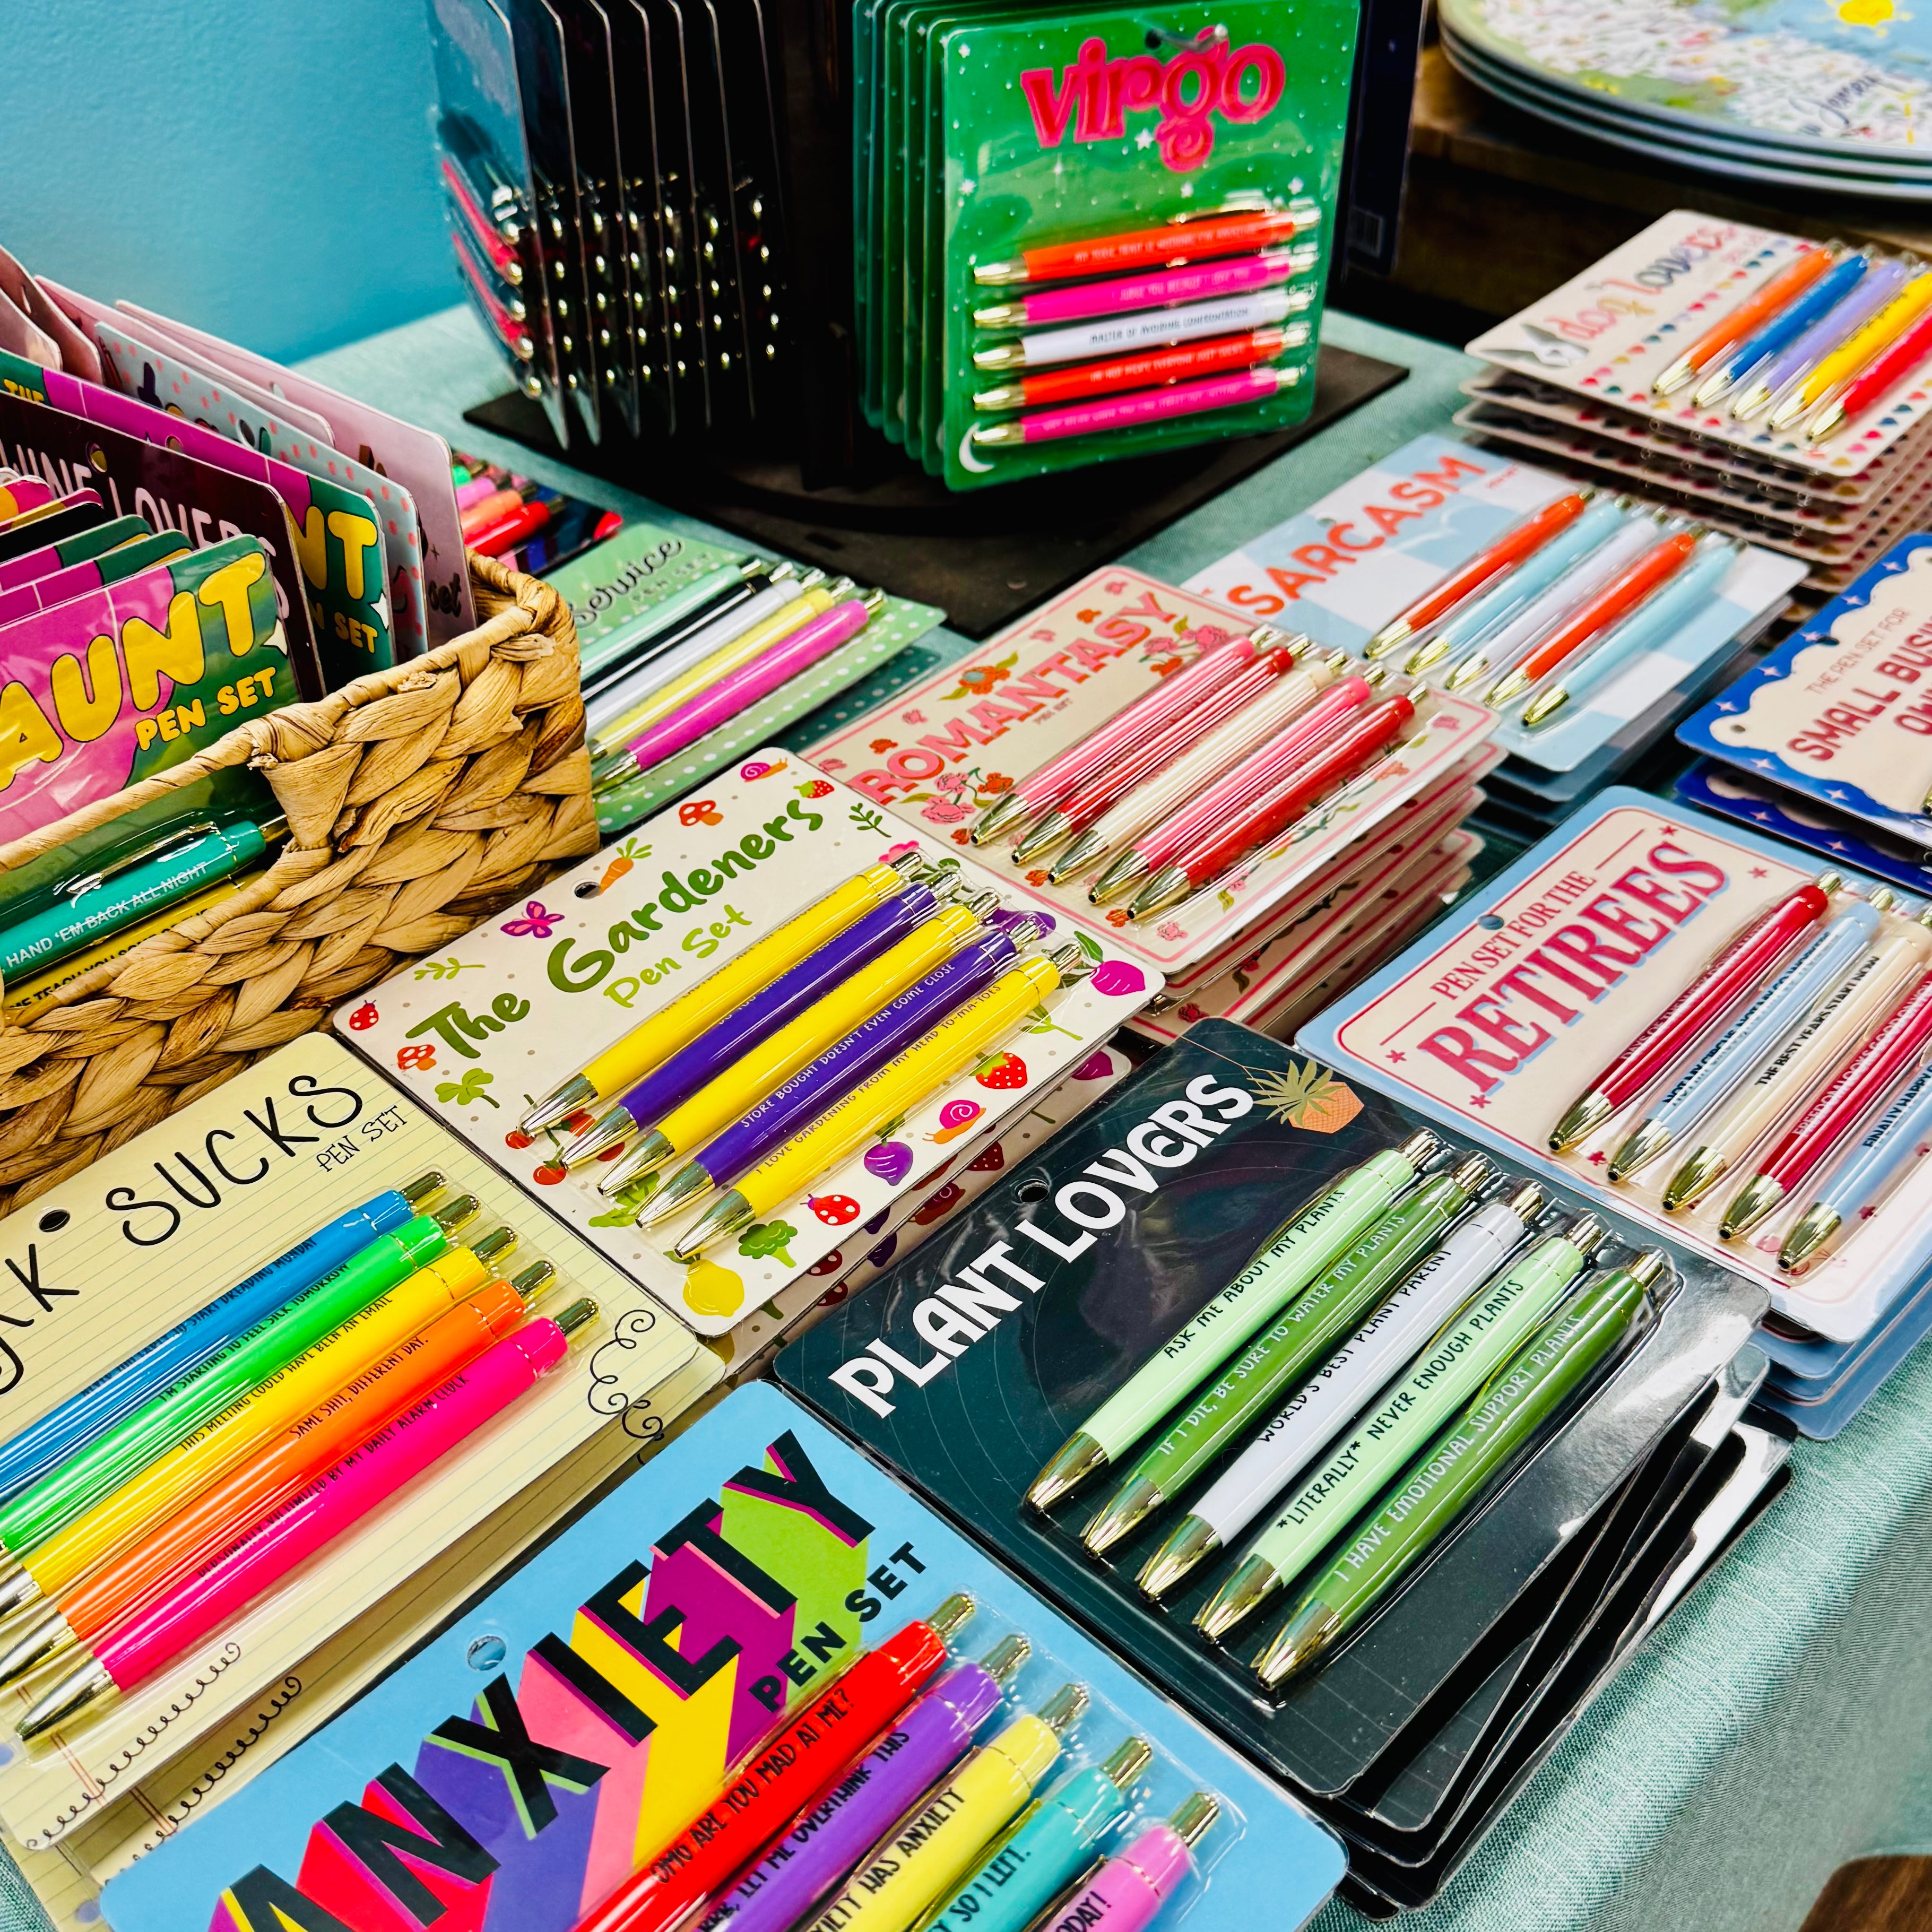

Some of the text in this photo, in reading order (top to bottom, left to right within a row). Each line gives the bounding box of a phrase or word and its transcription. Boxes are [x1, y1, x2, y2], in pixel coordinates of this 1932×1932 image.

[1021, 25, 1286, 173] virgo
[1227, 456, 1486, 616] SARCASM
[334, 612, 378, 654] SET
[847, 591, 1176, 805] ROMANTASY
[1804, 607, 1911, 694] THE PEN SET FOR
[134, 666, 276, 751] PEN SET
[1787, 688, 1901, 761] SMALL
[5, 935, 54, 969] HAND
[83, 898, 130, 931] BACK
[128, 883, 162, 908] ALL
[160, 860, 209, 894] NIGHT
[405, 1001, 530, 1059] The
[547, 799, 824, 993] Gardeners
[603, 956, 681, 1008] Pen
[681, 904, 753, 959] Set
[1416, 841, 1729, 1095] RETIREES
[1430, 870, 1598, 1000] PEN SET FOR THE
[741, 963, 955, 1128] STORE BOUGHT DOESN'T EVEN COME CLOSE
[764, 1145, 793, 1167] LOVE
[794, 1095, 856, 1143] GARDENING
[857, 1068, 891, 1093] FROM
[892, 1051, 910, 1067] MY
[911, 1031, 938, 1052] HEAD
[940, 981, 1001, 1029] TO-MA-TOES
[1754, 1064, 1780, 1091] THE
[1772, 1039, 1803, 1071] BEST
[1795, 1008, 1831, 1046] YEARS
[1823, 977, 1859, 1015] START
[1852, 953, 1881, 983] NOW
[1894, 1068, 1932, 1111] HAPPY
[106, 1075, 363, 1246] SUCKS
[316, 1105, 408, 1173] PEN SET
[1791, 1078, 1849, 1142] FREEDOM
[187, 1299, 221, 1327] START
[219, 1263, 276, 1306] DREADING
[271, 1235, 318, 1271] MONDAY
[828, 1075, 1254, 1419] PLANT LOVERS
[1164, 1190, 1345, 1358] ASK ME ABOUT MY PLANTS
[158, 1261, 350, 1402] I'M STARTING TO FEEL SICK TOMORROW
[178, 1291, 393, 1451] THIS MEETING COULD HAVE BEEN AN EMAIL
[291, 1335, 429, 1439] SAME SHIT, DIFFERENT DAY.
[1157, 1214, 1406, 1455] IF I DIE, BE SURE TO WATER MY PLANTS
[1257, 1250, 1452, 1442] WORLD'S BEST PLANT PARENT
[1366, 1392, 1416, 1440] NEVER
[1413, 1332, 1473, 1390] ENOUGH
[1470, 1279, 1523, 1331] PLANTS
[325, 1464, 345, 1483] BY
[342, 1448, 367, 1470] MY
[362, 1425, 397, 1456] DAILY
[394, 1395, 438, 1432] ALARM
[432, 1370, 472, 1403] CLOCK
[1333, 1314, 1587, 1582] I HAVE EMOTIONAL SUPPORT PLANTS
[748, 1541, 927, 1713] PEN SET
[689, 1812, 728, 1849] ARE
[721, 1778, 759, 1814] YOU
[754, 1743, 797, 1784] MAD
[795, 1722, 821, 1749] AT
[815, 1688, 854, 1728] ME?
[733, 1725, 912, 1901] LET ME OVERTHINK THIS
[857, 1856, 900, 1894] HAS
[896, 1787, 965, 1858] ANXIETY
[949, 1845, 1031, 1922] SO I LEFT.
